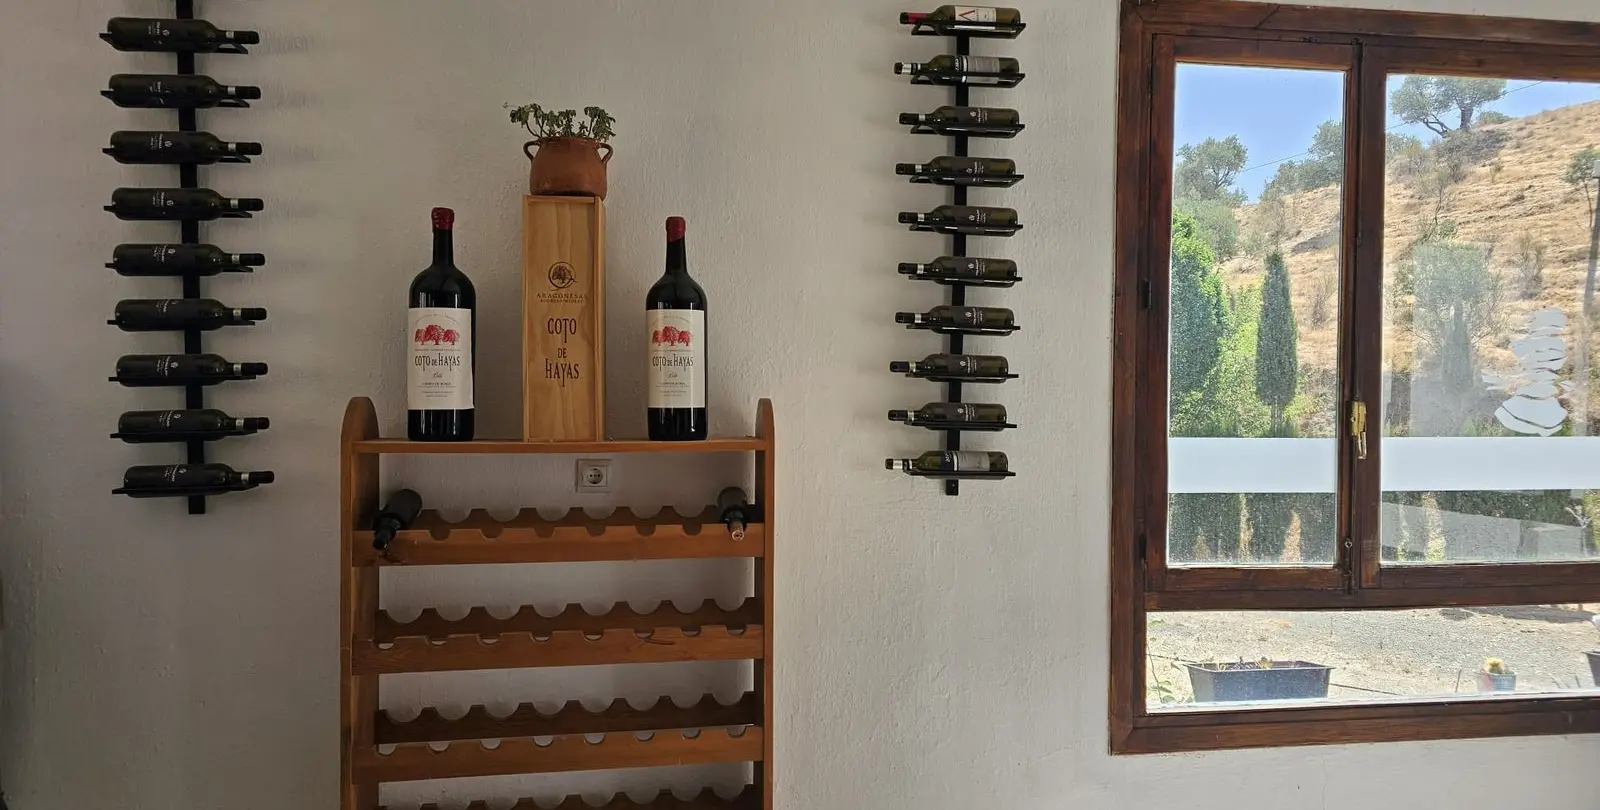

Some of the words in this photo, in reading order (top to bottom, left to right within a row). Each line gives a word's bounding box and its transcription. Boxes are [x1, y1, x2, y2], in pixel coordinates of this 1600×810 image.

[547, 317, 577, 344] COTO
[414, 355, 431, 371] COTO
[431, 358, 438, 366] DE
[438, 352, 461, 371] HAYAS
[557, 347, 567, 359] DE
[652, 356, 667, 372] COTO
[667, 359, 673, 367] DE
[673, 353, 694, 372] HAYAS
[545, 358, 580, 387] HAYAS
